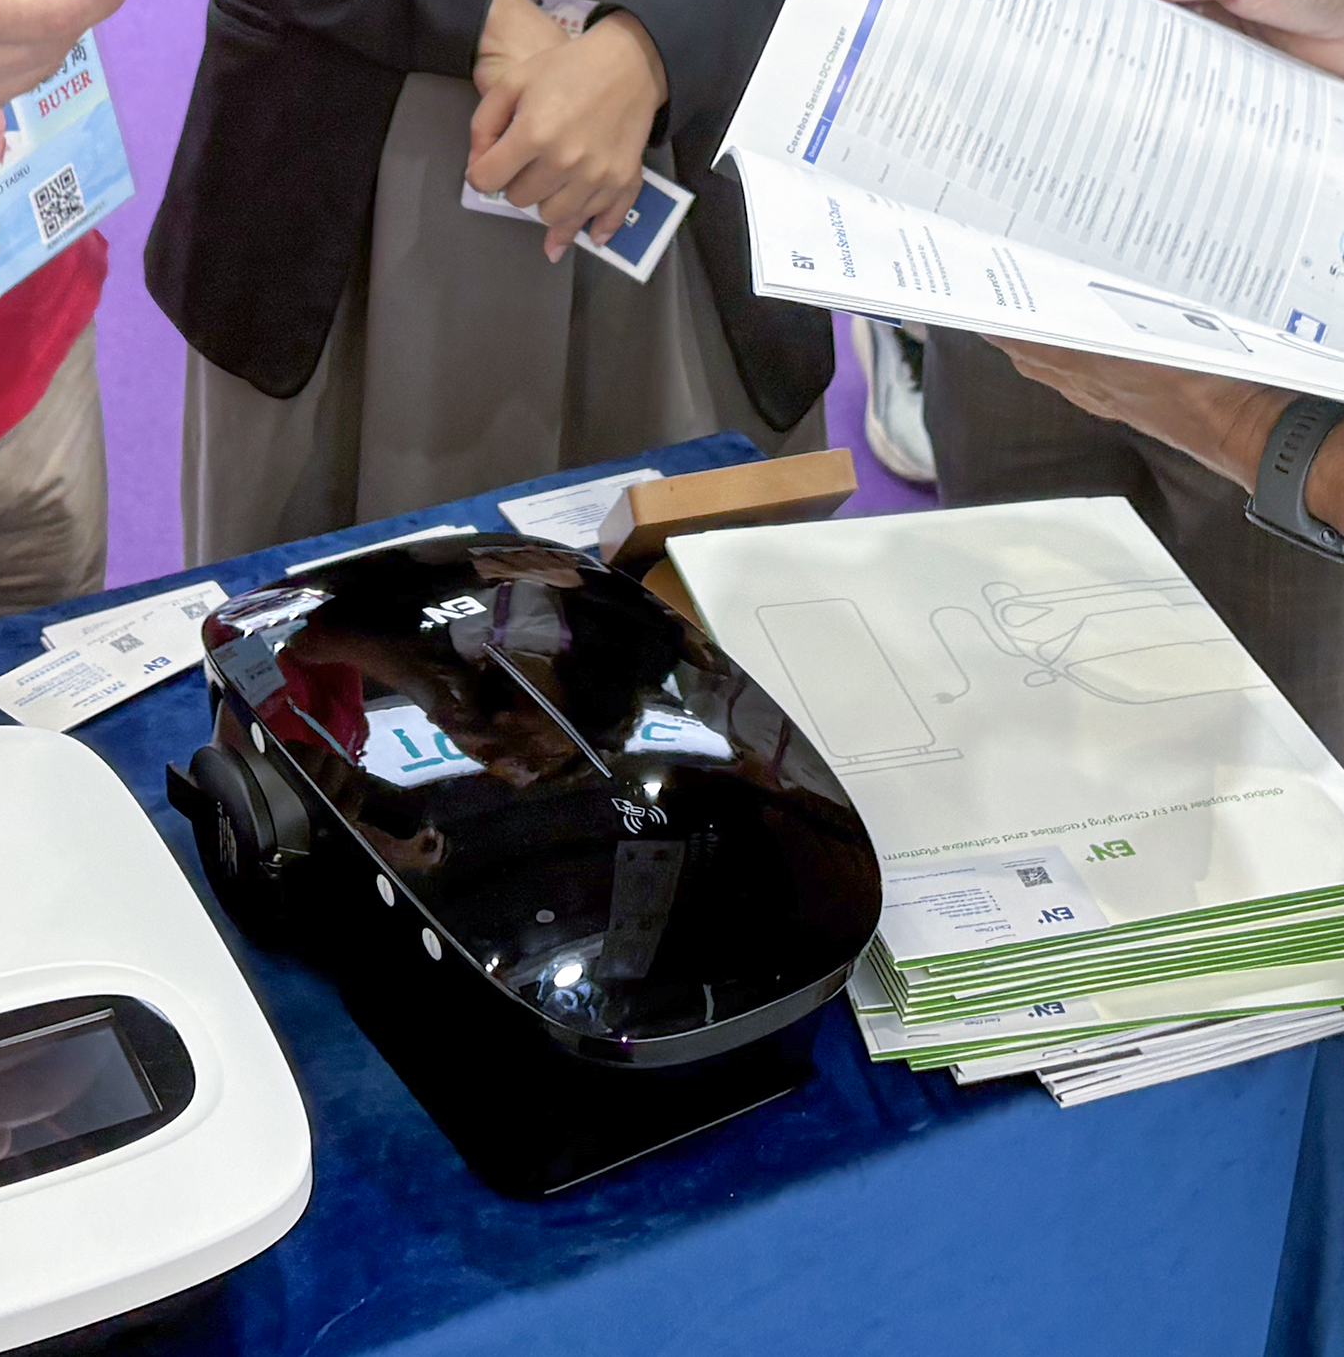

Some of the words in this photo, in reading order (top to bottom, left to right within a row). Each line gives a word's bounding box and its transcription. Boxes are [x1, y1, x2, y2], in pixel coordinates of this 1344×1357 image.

[37, 69, 93, 119] BUYER
[786, 110, 812, 155] Corebox
[804, 77, 826, 111] Series
[818, 62, 832, 80] DC
[825, 25, 848, 64] Charger
[419, 596, 487, 628] EN+
[1086, 811, 1149, 827] Charging
[942, 836, 1000, 852] Software
[1001, 830, 1029, 843] and
[882, 845, 941, 860] Platform
[1086, 839, 1136, 863] EN+
[1038, 906, 1075, 925] EN+
[1028, 1002, 1065, 1019] EN+
